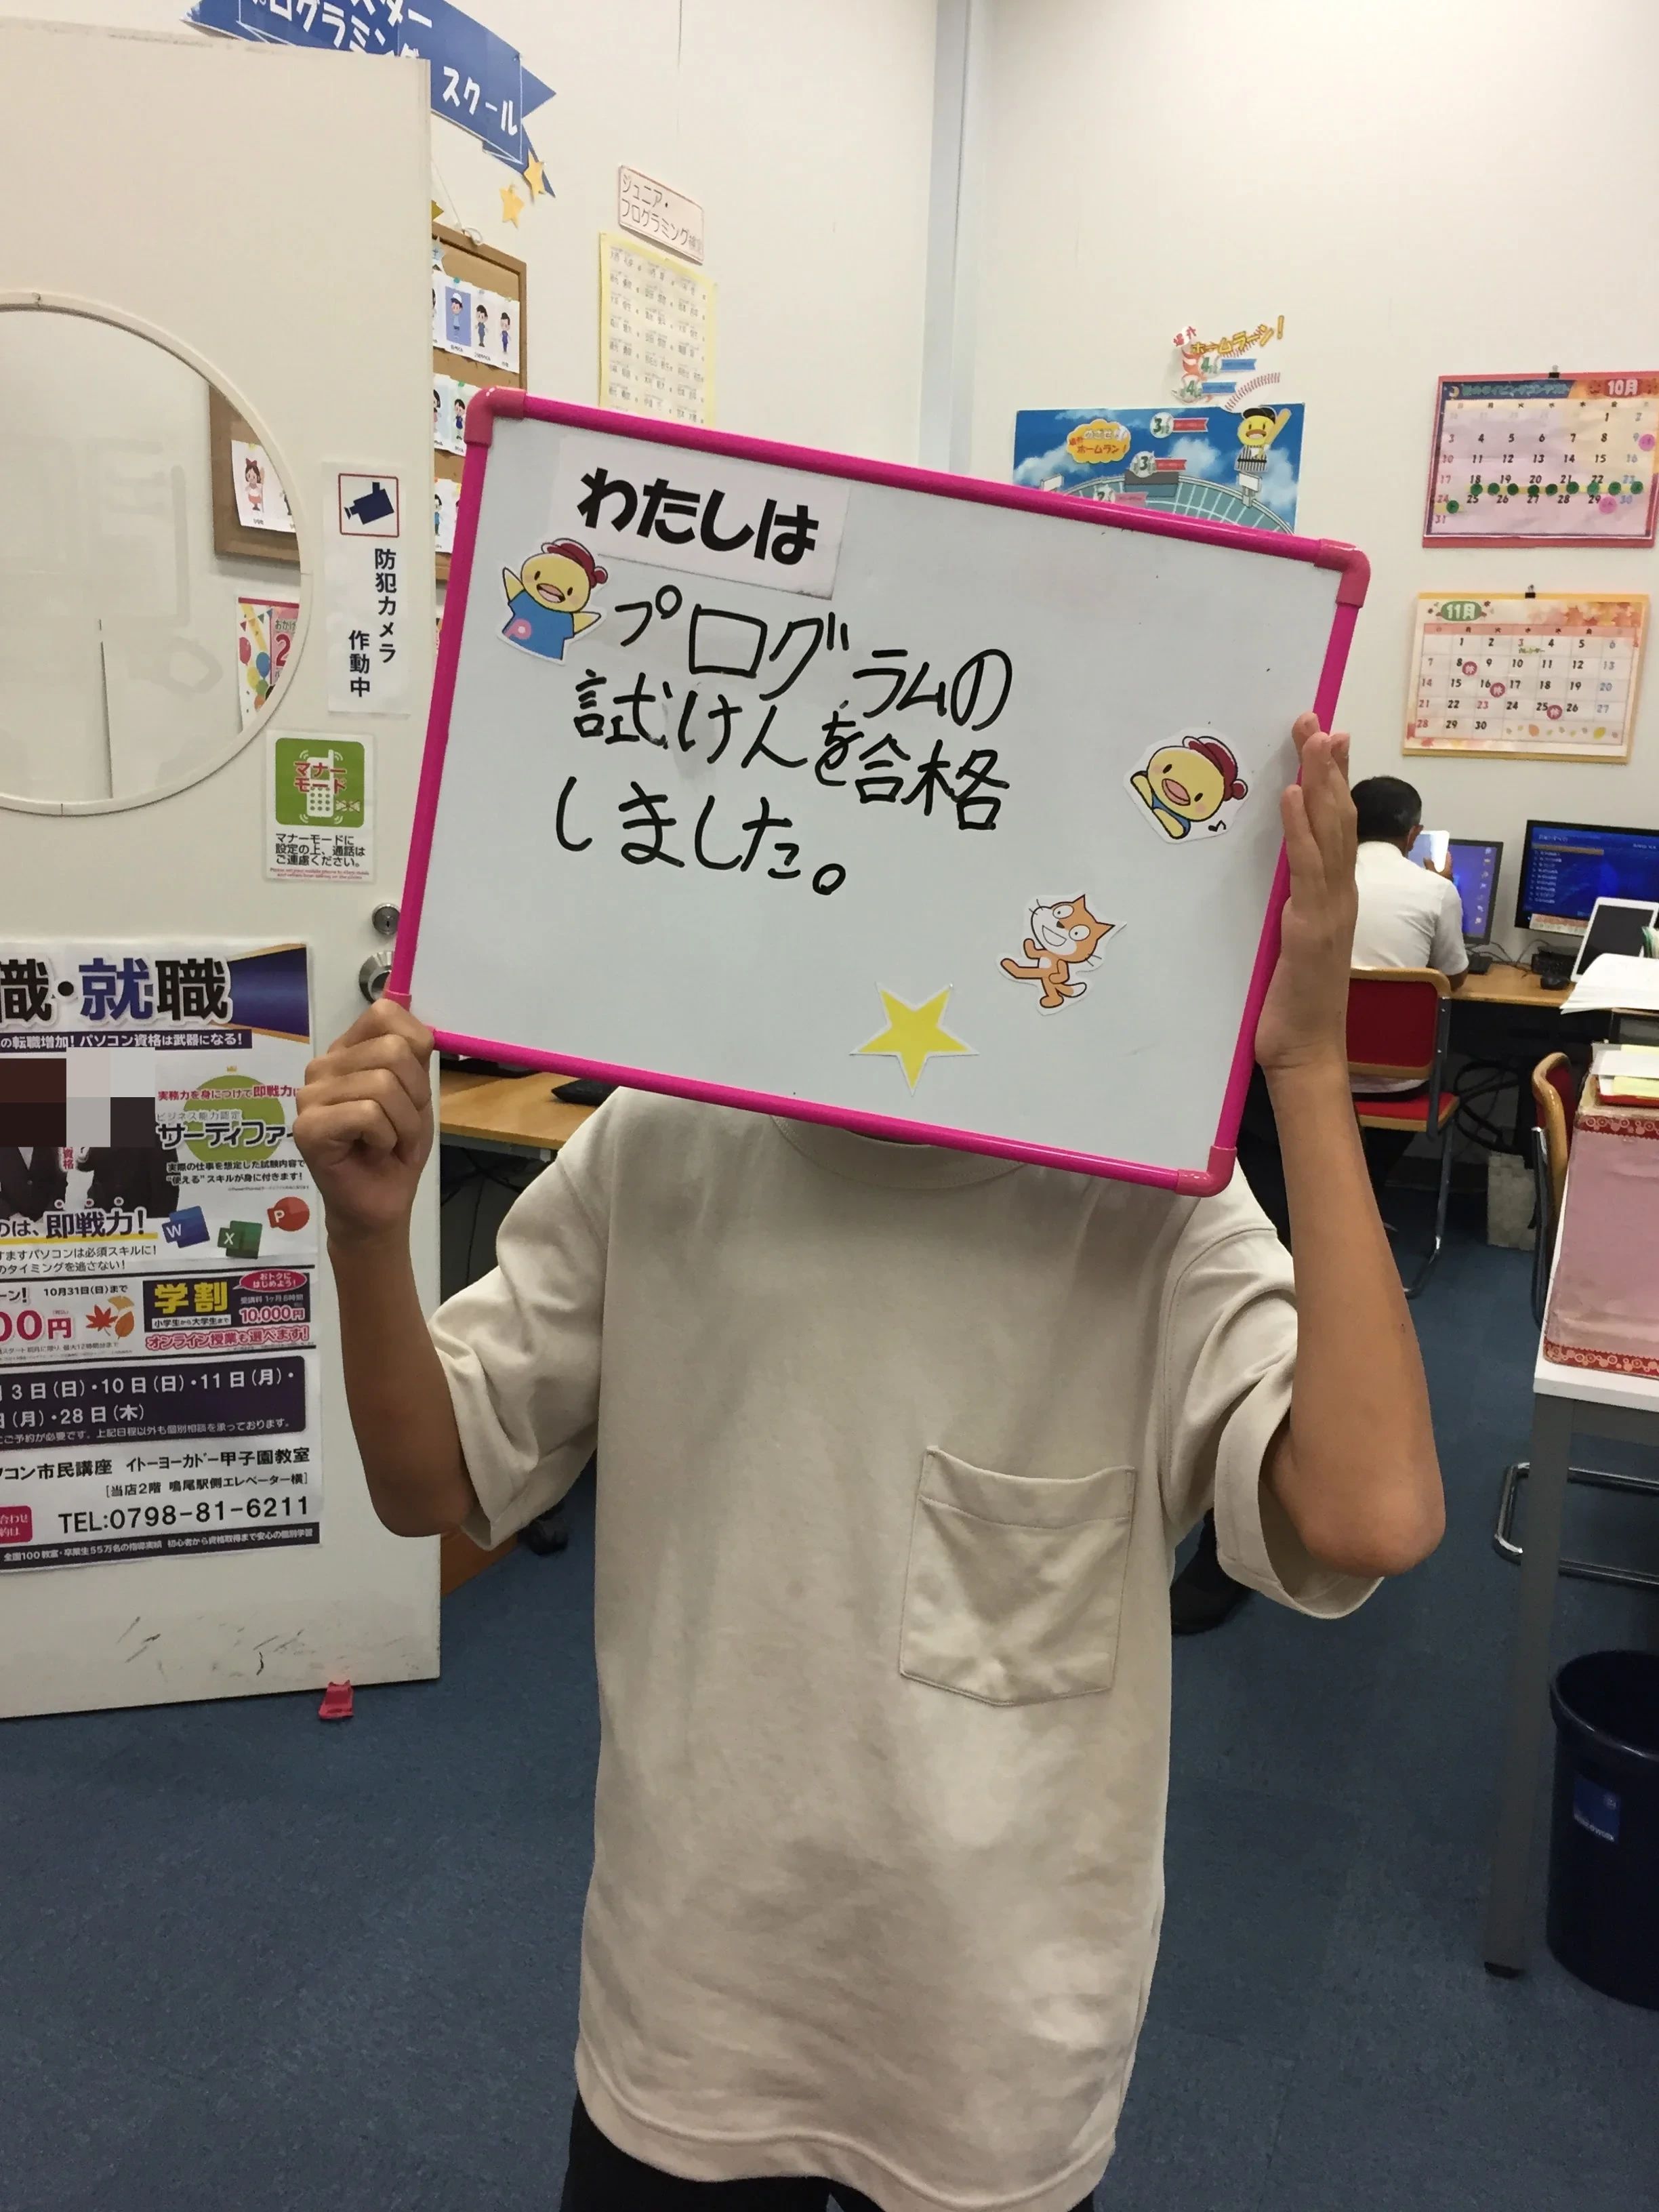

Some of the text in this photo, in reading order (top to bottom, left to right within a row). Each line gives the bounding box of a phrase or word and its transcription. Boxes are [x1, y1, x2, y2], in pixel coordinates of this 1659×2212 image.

[443, 66, 518, 136] スクール
[1607, 379, 1639, 396] 10月
[1604, 412, 1610, 422] 1
[1448, 433, 1455, 443] 3
[1477, 433, 1485, 443] 4
[1508, 433, 1515, 443] 5
[1538, 433, 1545, 443] 6
[1570, 433, 1577, 443] 7
[1600, 432, 1607, 443] 8
[1441, 453, 1639, 464] 10 11 12 13 14 15 16
[1440, 474, 1452, 485] 17
[1469, 474, 1481, 484] 18
[1500, 474, 1512, 484] 19
[1529, 474, 1542, 484] 20
[1559, 474, 1572, 484] 21
[1591, 474, 1604, 484] 22
[1466, 495, 1479, 504] 25
[1496, 495, 1509, 504] 26
[1526, 495, 1540, 504] 27
[1557, 495, 1570, 504] 28
[1588, 495, 1602, 504] 29
[576, 466, 819, 567] わたしは
[375, 548, 398, 663] 防犯カメラ
[1446, 603, 1476, 621] 11月
[1459, 637, 1465, 646] 1
[1488, 638, 1494, 647] 2
[1547, 638, 1555, 647] 4
[1578, 639, 1585, 648] 5
[348, 630, 371, 698] 作動中
[615, 585, 1013, 731] プログラムの
[1427, 657, 1615, 670] 7 8 9 10 11 12 13
[1450, 678, 1462, 688] 15
[1480, 679, 1491, 689] 16
[1509, 680, 1521, 689] 17
[1540, 680, 1551, 690] 18
[1570, 681, 1582, 691] 19
[1599, 682, 1612, 692] 20
[1418, 699, 1610, 714] 21 22 23 24 25 26 27
[1416, 719, 1487, 730] 28 29 30
[573, 668, 1010, 831] 試けんを合格
[294, 762, 346, 777] マナー
[294, 777, 346, 794] モード
[276, 833, 354, 845] マナーモードに
[556, 777, 846, 896] しました。
[275, 843, 365, 857] 設定の上、通話は
[158, 1120, 293, 1148] サーティファ
[274, 1209, 285, 1223] P
[167, 1225, 182, 1238] W
[224, 1231, 235, 1245] X
[154, 1281, 228, 1314] 学割
[146, 1325, 309, 1350] オンライン授業も選べます！
[0, 1367, 294, 1402] 3日(日)・10日(日)・11日(月)・
[0, 1447, 310, 1481] コン市民講座 イトーヨーカドー甲子園教室
[58, 1496, 307, 1534] TEL:0798-81-6211
